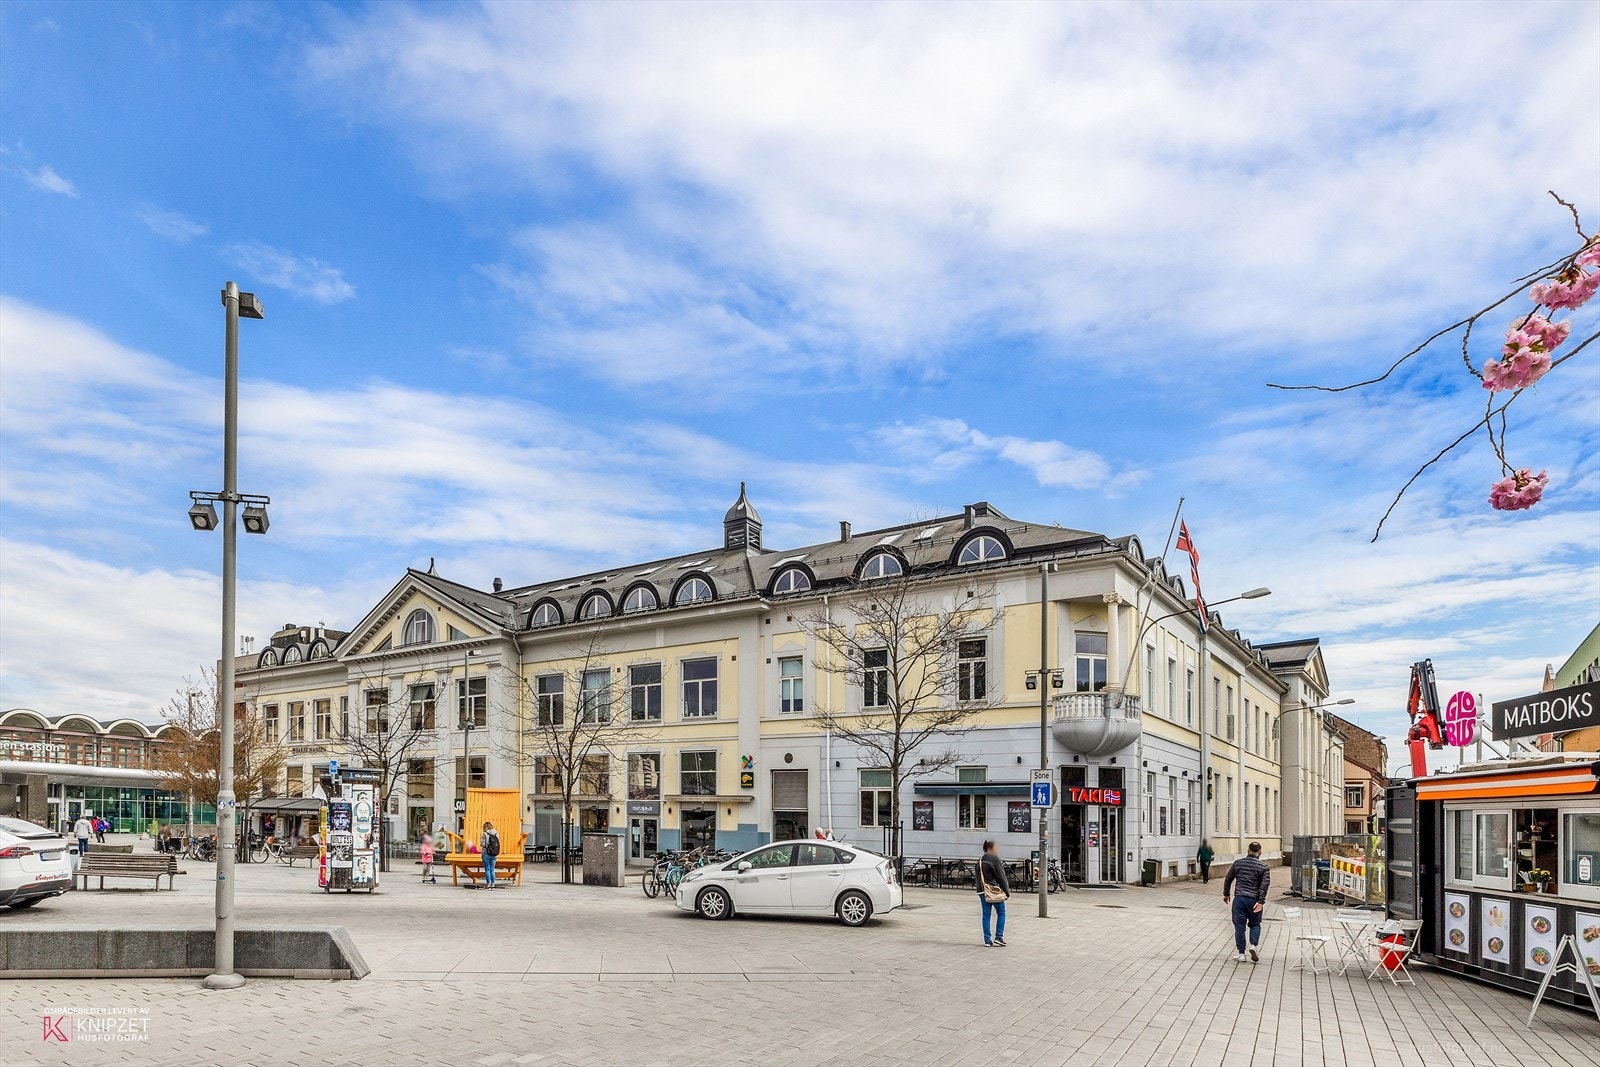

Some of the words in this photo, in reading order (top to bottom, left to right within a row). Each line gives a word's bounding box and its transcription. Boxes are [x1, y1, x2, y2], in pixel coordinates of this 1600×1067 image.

[1504, 692, 1593, 729] MATBOKS
[20, 742, 60, 754] stasjon
[1034, 771, 1050, 779] Sone
[1068, 787, 1102, 803] TAKI
